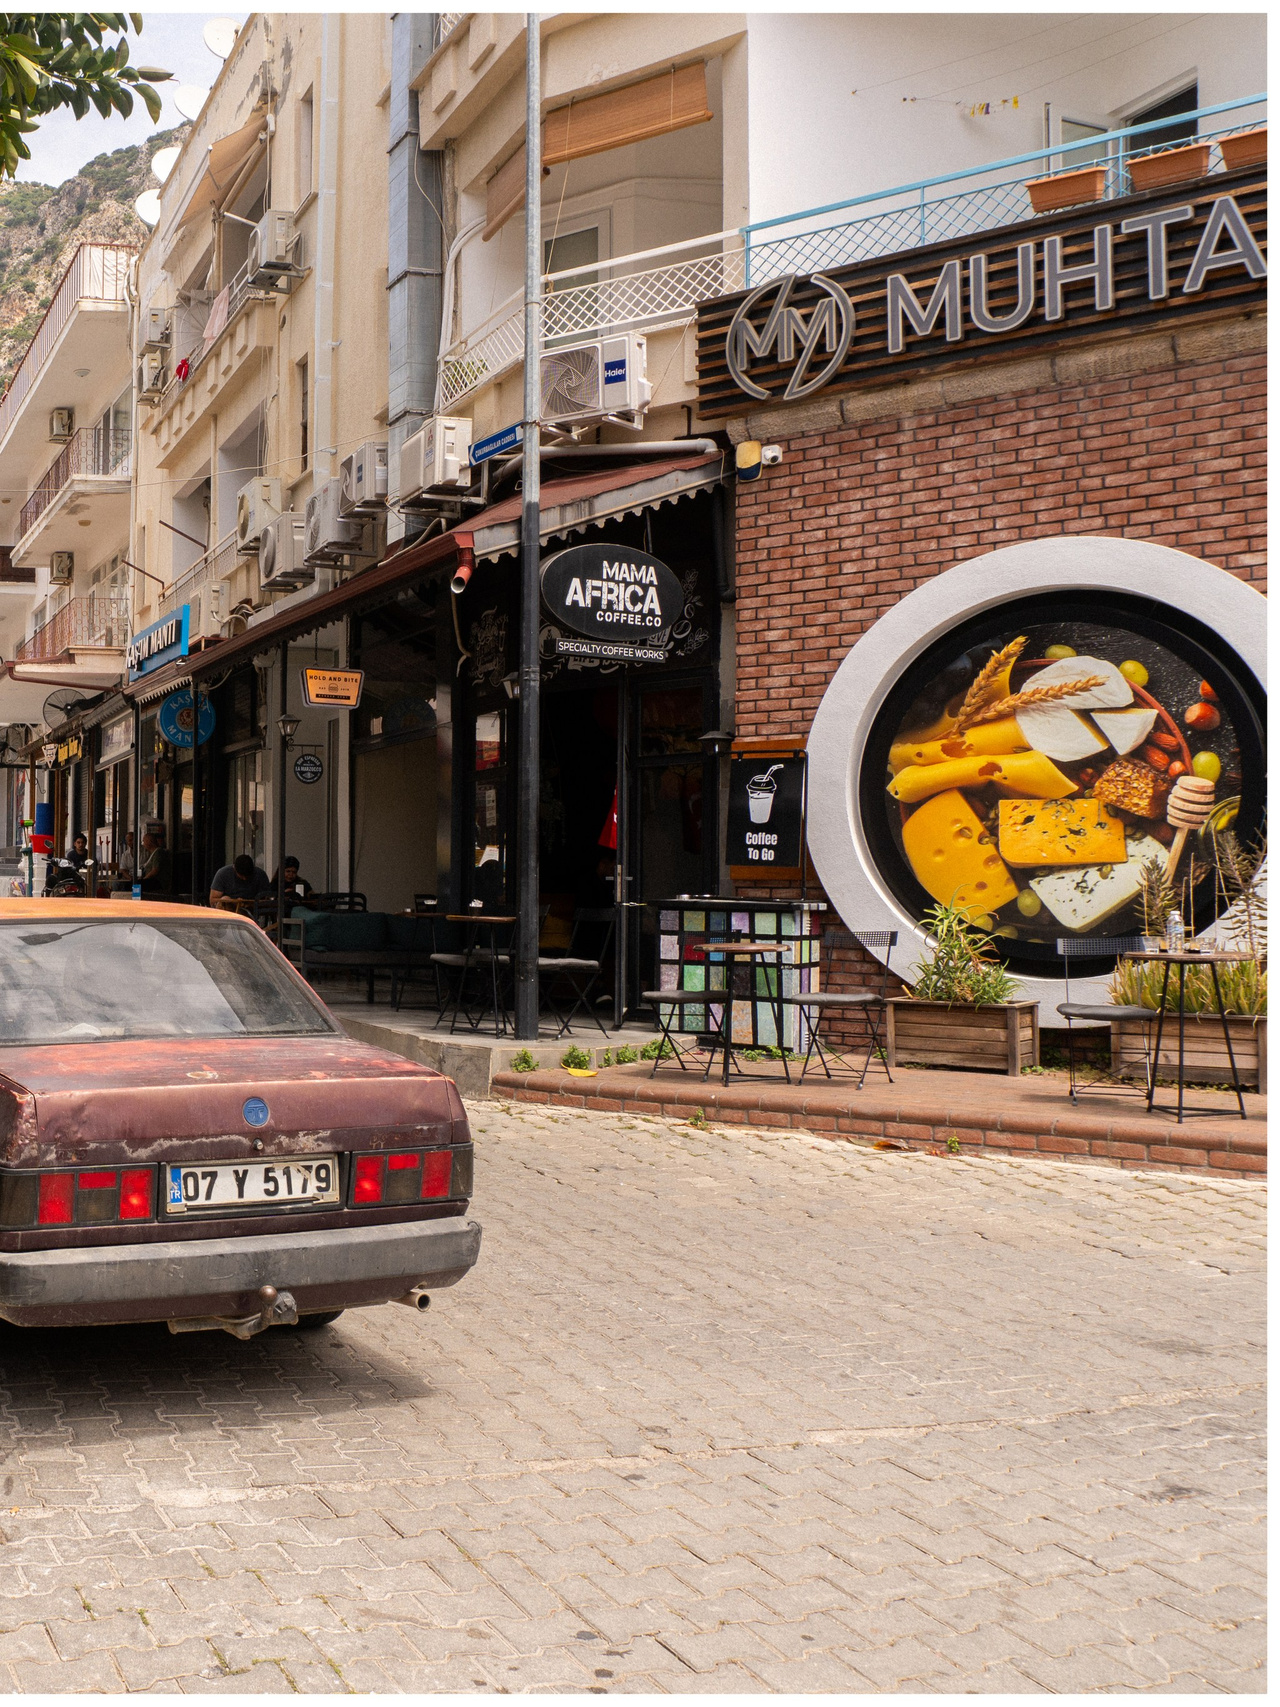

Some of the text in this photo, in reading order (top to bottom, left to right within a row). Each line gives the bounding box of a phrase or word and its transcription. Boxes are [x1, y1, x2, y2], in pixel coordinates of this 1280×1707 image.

[886, 196, 1267, 355] MUHTA
[605, 368, 626, 377] Haier
[602, 560, 658, 585] MAMA
[565, 577, 662, 615] AFRICA
[596, 610, 662, 627] COFFEE.CO
[150, 619, 176, 655] MANTI
[558, 641, 664, 660] SPECIALTY COFFEE WORKS
[167, 724, 206, 743] MANI
[745, 832, 778, 845] Coffee
[747, 847, 775, 861] To Go
[182, 1163, 331, 1202] 07 Y 5179
[170, 1190, 181, 1199] TR
